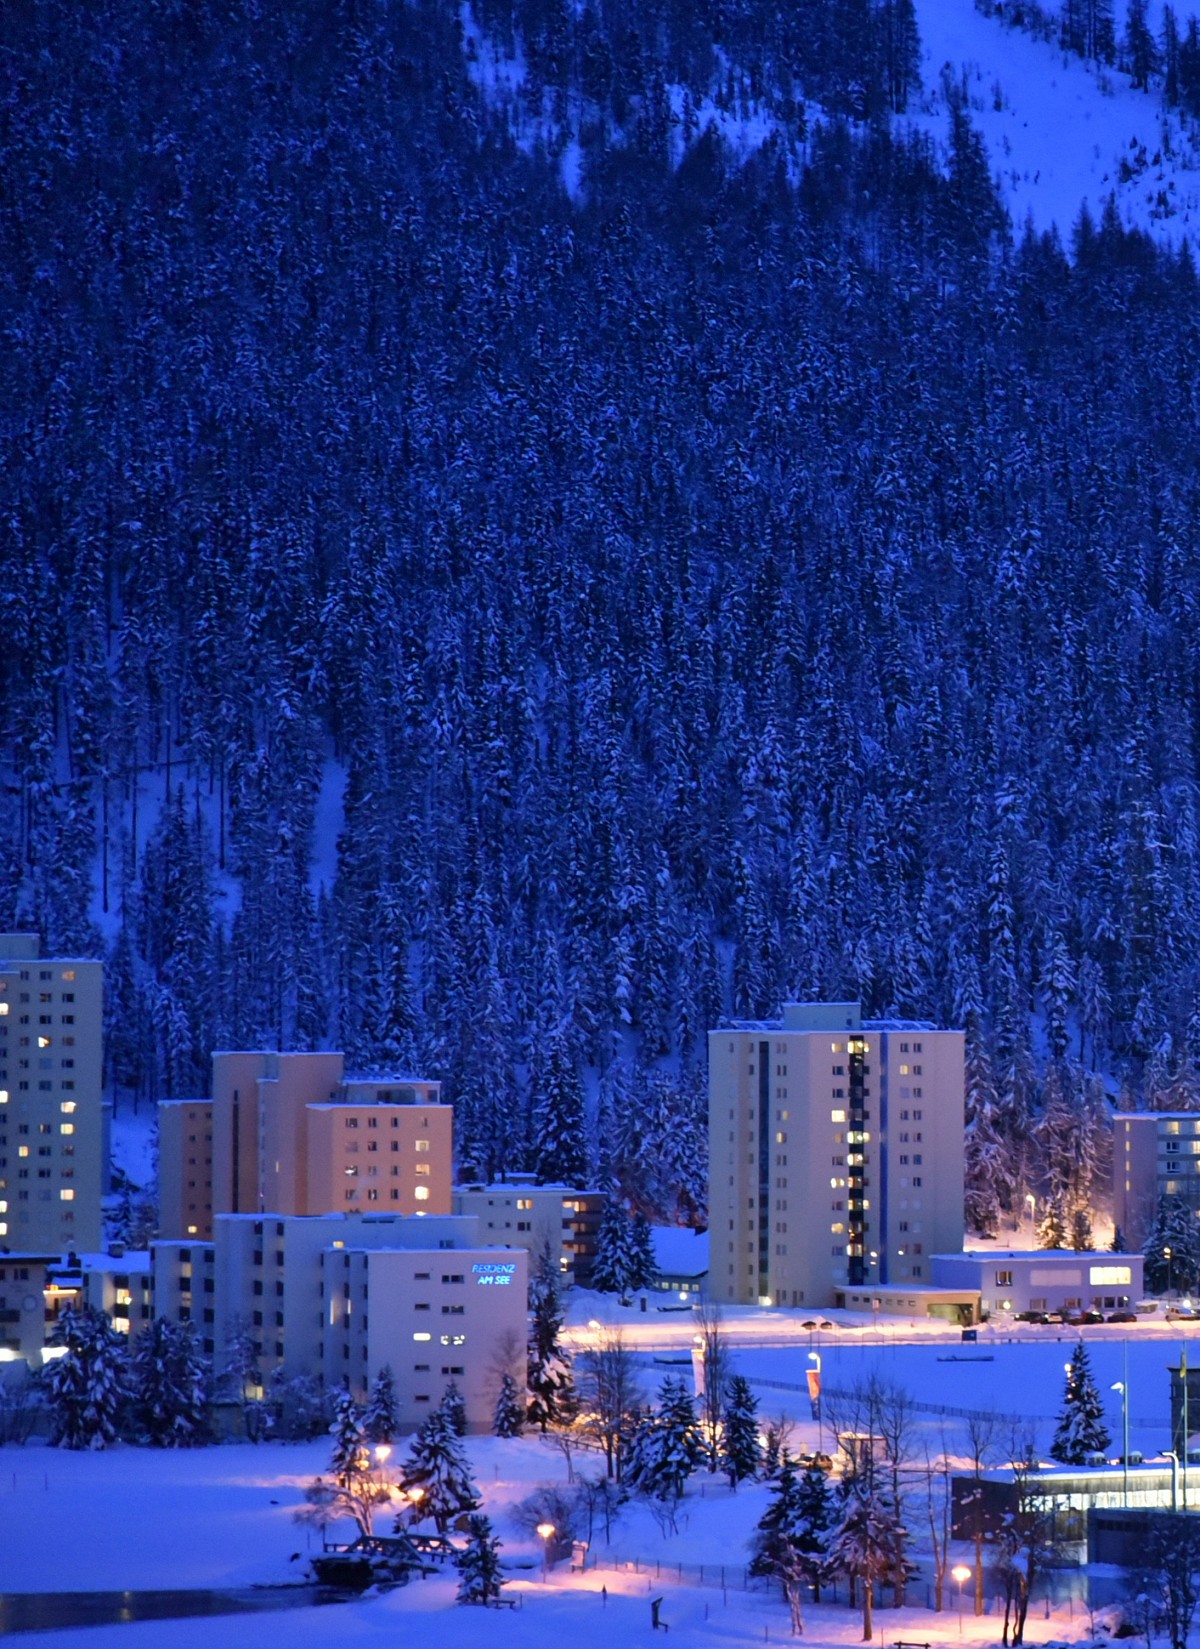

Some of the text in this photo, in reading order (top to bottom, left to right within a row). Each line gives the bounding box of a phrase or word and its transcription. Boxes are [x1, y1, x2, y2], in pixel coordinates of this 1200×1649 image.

[472, 1264, 516, 1273] RESIDENZ
[477, 1275, 511, 1285] AM SEE
